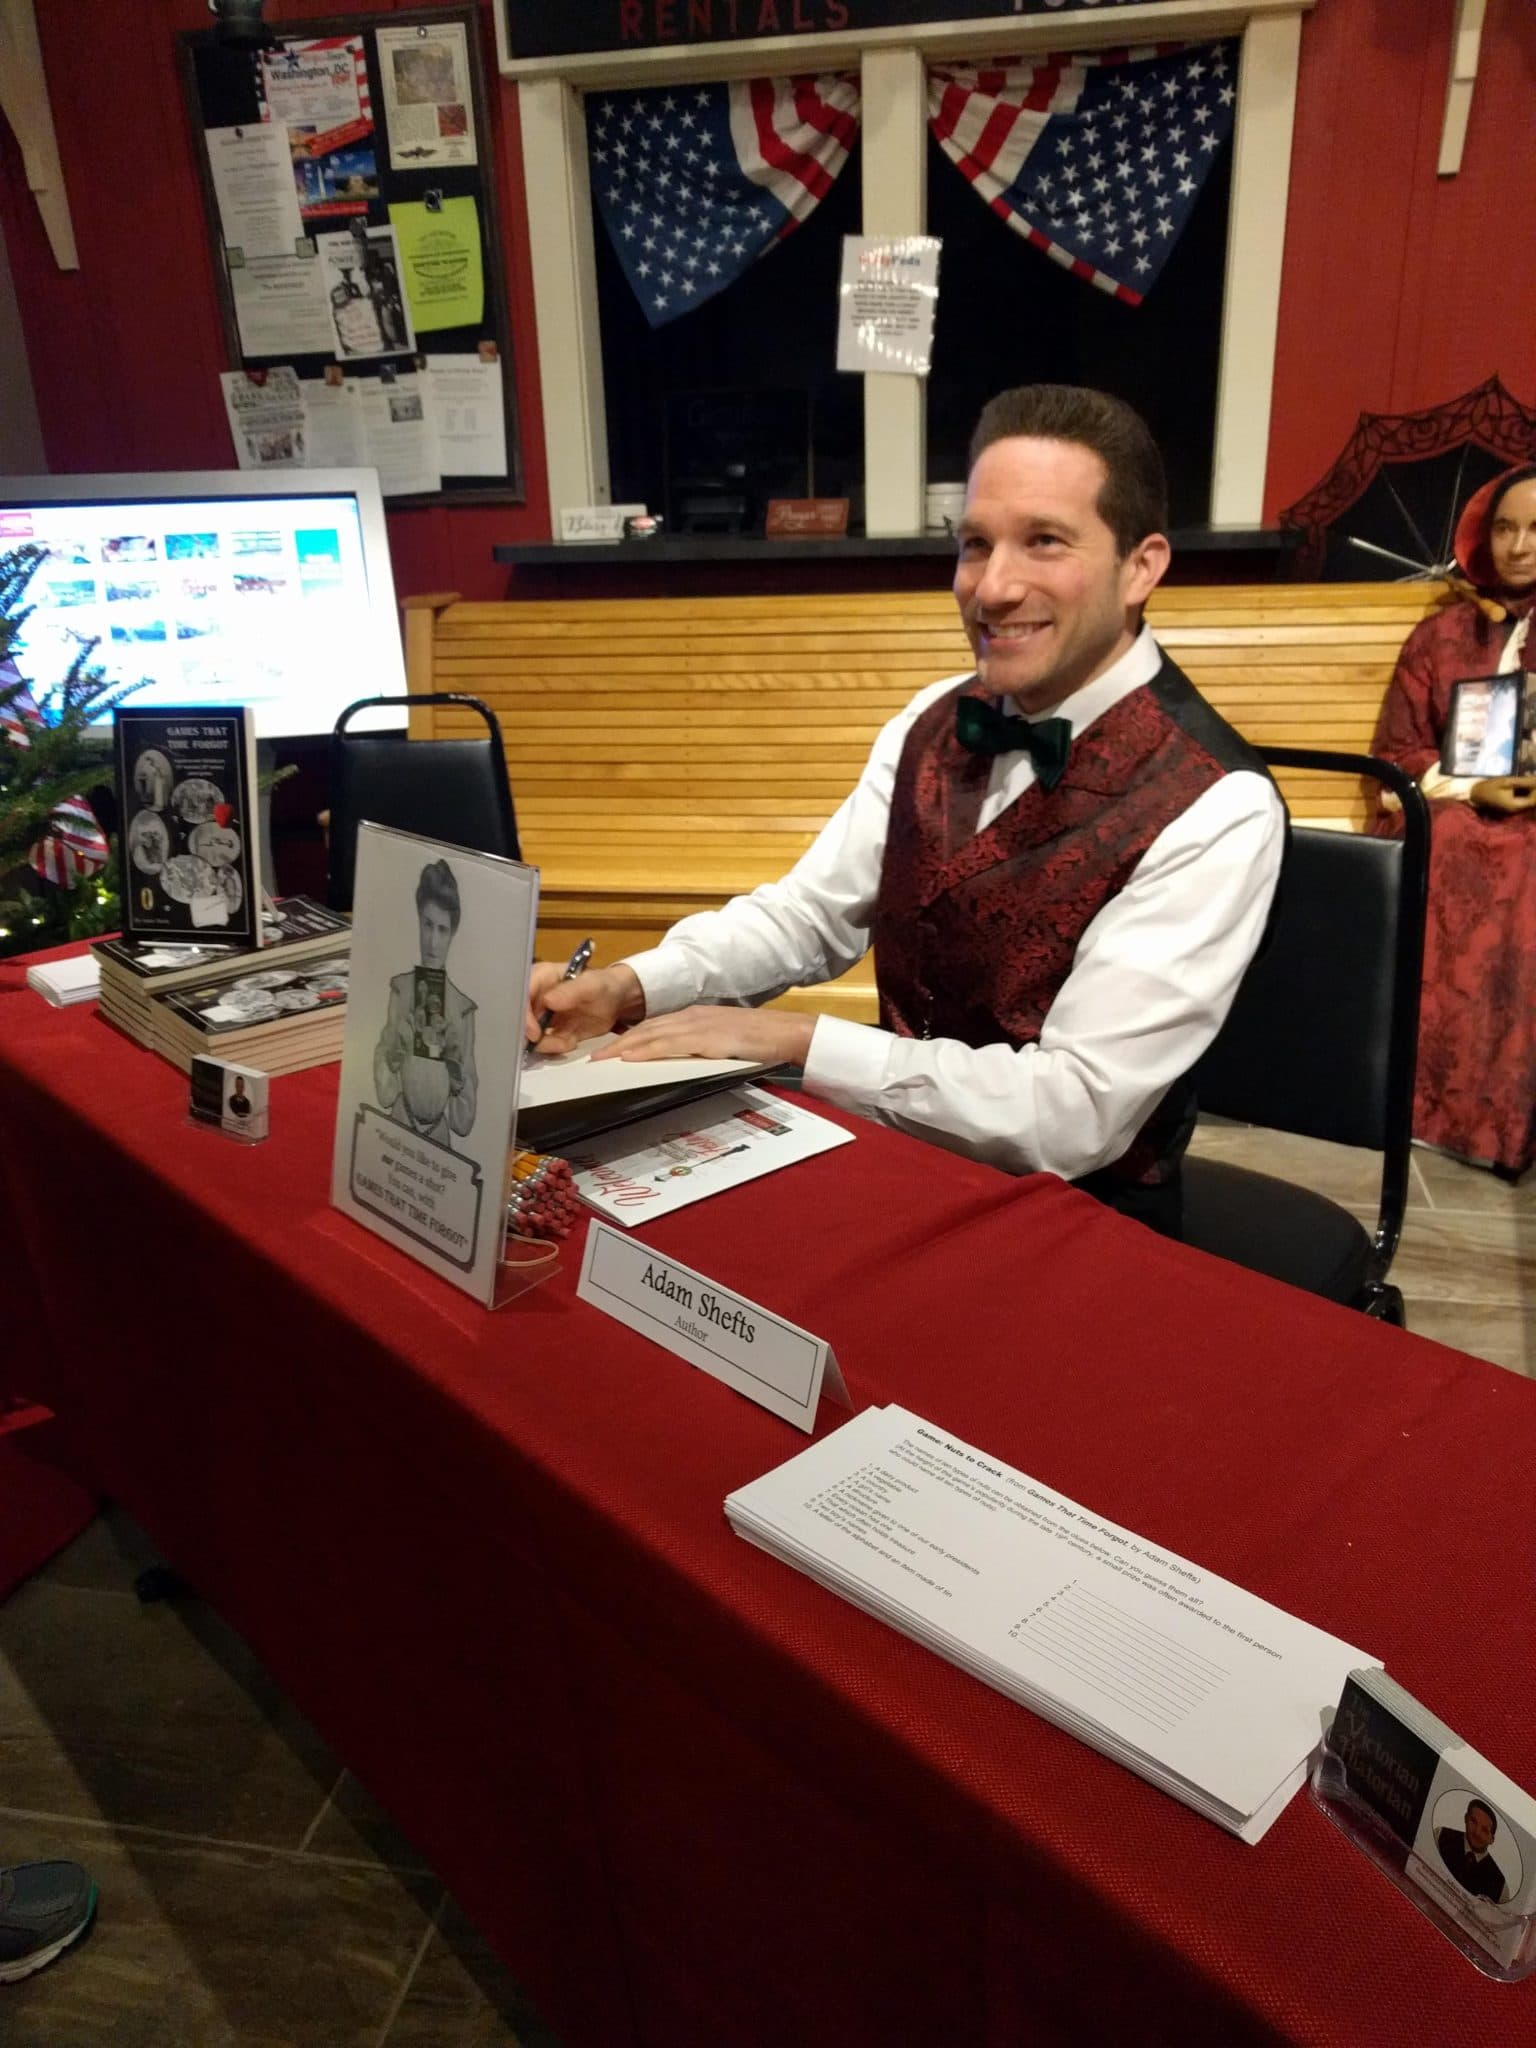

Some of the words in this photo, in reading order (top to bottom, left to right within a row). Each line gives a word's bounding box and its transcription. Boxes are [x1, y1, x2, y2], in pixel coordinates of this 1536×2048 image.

[620, 0, 850, 41] RENTALS
[384, 1188, 406, 1212] THAT
[407, 1202, 428, 1228] TIME
[640, 1262, 693, 1310] Adam
[697, 1292, 756, 1344] Shefts
[673, 1314, 710, 1343] Author
[887, 1449, 902, 1457] who
[917, 1466, 935, 1476] name
[952, 1486, 972, 1497] types
[893, 1478, 920, 1493] product
[873, 1492, 891, 1503] name
[915, 1428, 943, 1444] Game:
[943, 1443, 966, 1456] Nuts
[975, 1460, 1004, 1477] Crack
[1005, 1476, 1028, 1490] (from
[1026, 1488, 1057, 1506] Games
[1056, 1505, 1077, 1517] That
[1076, 1516, 1099, 1529] Time
[1142, 1550, 1169, 1566] Adam
[1168, 1564, 1202, 1584] Shefts)
[845, 1520, 868, 1534] names
[867, 1515, 880, 1523] has
[879, 1522, 893, 1531] one
[871, 1509, 890, 1521] given
[896, 1524, 910, 1532] one
[916, 1536, 929, 1544] our
[927, 1543, 946, 1554] early
[944, 1552, 981, 1575] presidents
[901, 1439, 915, 1447] The
[913, 1446, 935, 1459] names
[950, 1466, 970, 1478] types
[976, 1480, 992, 1490] nuts
[990, 1489, 1004, 1497] can
[1012, 1500, 1043, 1518] obtained
[1041, 1516, 1059, 1527] from
[1058, 1525, 1071, 1533] the
[1112, 1555, 1130, 1566] Can
[1128, 1564, 1144, 1575] you
[1143, 1573, 1168, 1588] guess
[1167, 1585, 1188, 1598] them
[1188, 1595, 1205, 1606] all?
[840, 1526, 852, 1534] the
[877, 1549, 892, 1559] and
[899, 1563, 917, 1574] item
[914, 1572, 935, 1585] made
[942, 1589, 954, 1597] tin
[888, 1537, 916, 1554] treasure
[940, 1469, 953, 1477] this
[1004, 1506, 1028, 1520] during
[1027, 1518, 1040, 1526] the
[1101, 1558, 1123, 1571] small
[1121, 1569, 1141, 1582] prize
[1141, 1581, 1157, 1591] was
[1157, 1589, 1178, 1602] often
[1177, 1600, 1213, 1621] awarded
[1221, 1624, 1237, 1634] the
[1236, 1631, 1253, 1643] first
[1252, 1642, 1283, 1660] person
[1345, 1709, 1420, 1793] Victorian
